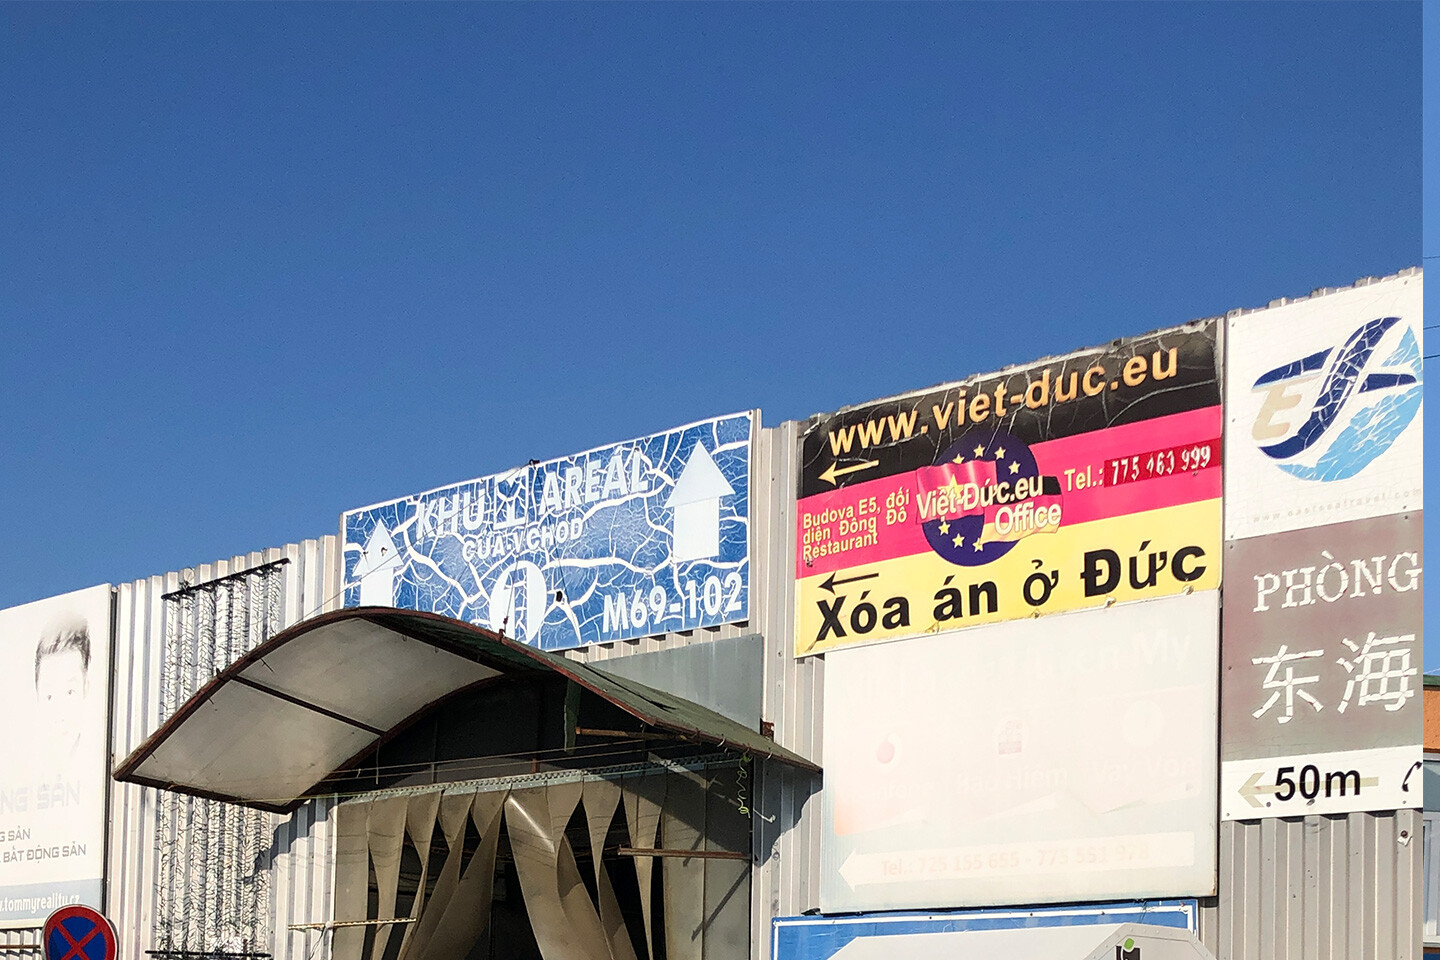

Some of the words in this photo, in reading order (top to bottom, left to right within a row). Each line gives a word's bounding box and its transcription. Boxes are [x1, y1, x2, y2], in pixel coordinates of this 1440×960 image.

[828, 347, 1179, 456] www.viet-duc.eu
[1064, 465, 1104, 492] Tel.:
[1111, 456, 1140, 485] 775
[1181, 444, 1211, 471] 999
[416, 489, 486, 537] KHU
[538, 449, 649, 516] AREAL
[803, 508, 854, 530] Budova
[886, 486, 910, 510] đối
[916, 476, 1044, 523] Việt-Đức.eu
[995, 501, 1062, 535] Office
[803, 532, 878, 561] Restaurant
[603, 572, 743, 632] M69-102
[816, 591, 911, 642] Xóa
[933, 575, 999, 622] án
[1023, 559, 1060, 607] ở
[1081, 540, 1207, 598] Đức
[1253, 550, 1422, 612] PHÒNG
[1252, 631, 1418, 724] 东海
[1275, 764, 1361, 801] 50m
[62, 841, 86, 857] SẢN
